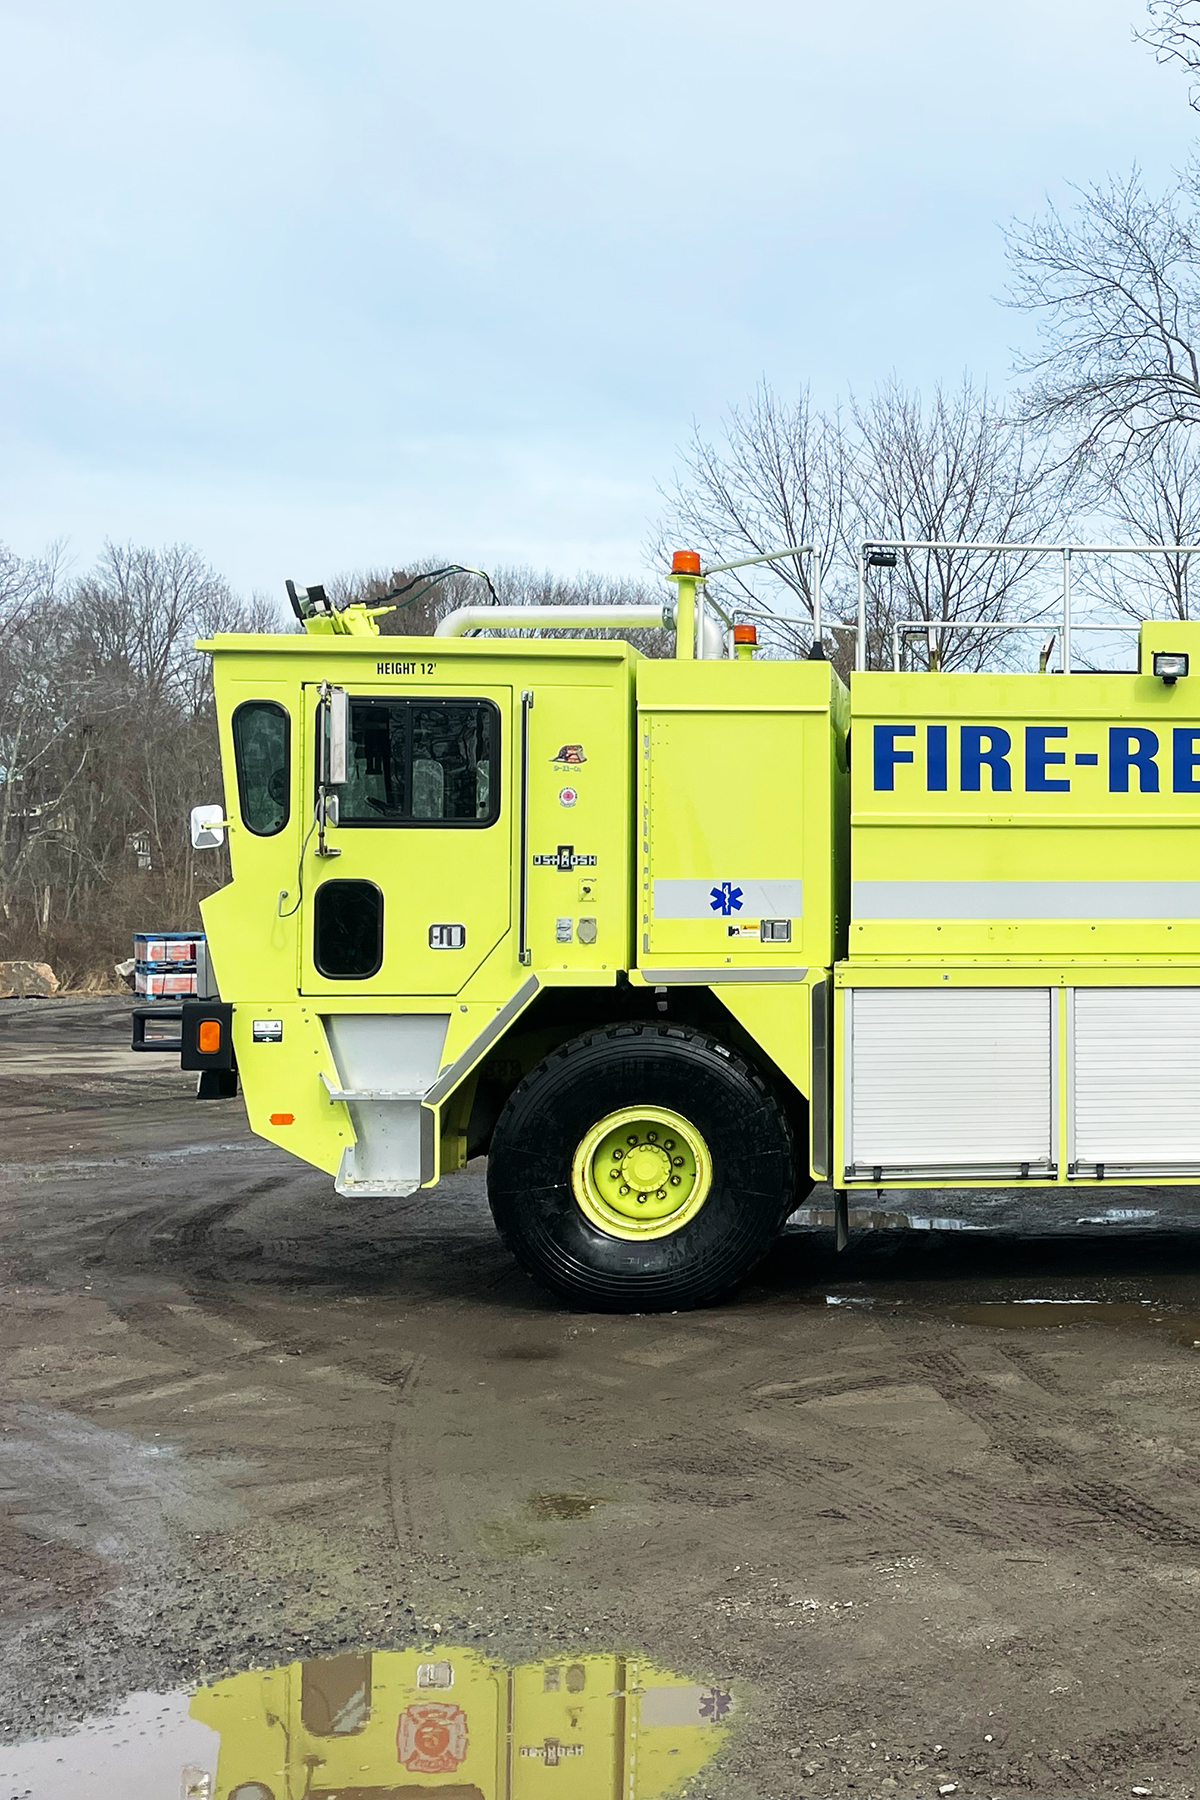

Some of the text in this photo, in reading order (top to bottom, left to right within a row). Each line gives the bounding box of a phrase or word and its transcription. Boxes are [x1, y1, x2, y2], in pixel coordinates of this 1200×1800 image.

[376, 662, 437, 675] HEIGHT 12'
[533, 848, 597, 868] OSHKOSH
